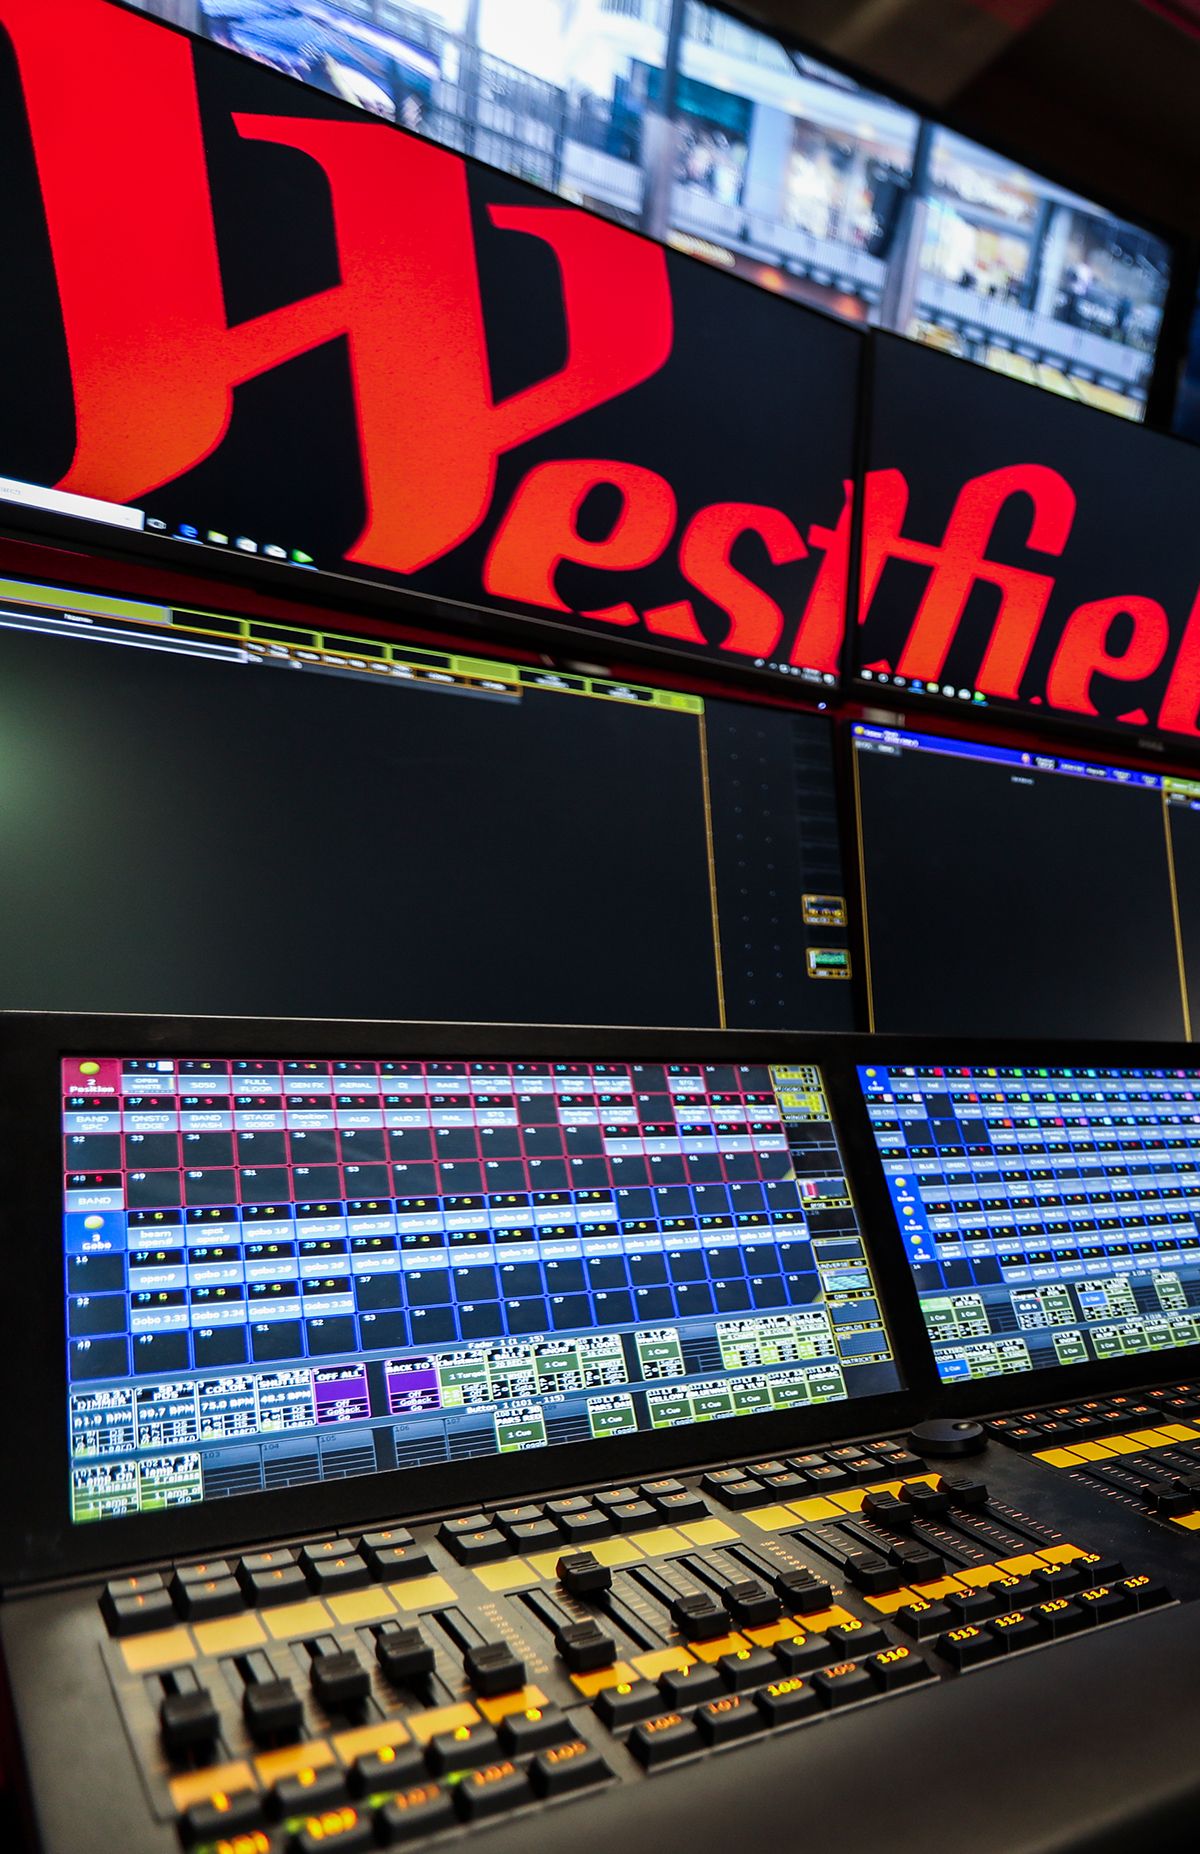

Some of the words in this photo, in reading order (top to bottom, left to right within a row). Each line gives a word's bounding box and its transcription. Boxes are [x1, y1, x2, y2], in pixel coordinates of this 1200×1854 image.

[69, 1085, 114, 1093] Position
[78, 1197, 112, 1206] BAND
[82, 1241, 112, 1251] Gobo
[834, 1448, 850, 1456] 14
[852, 1459, 869, 1467] 14
[652, 1479, 669, 1488] 10
[772, 1474, 789, 1482] 12
[669, 1492, 686, 1501] 10
[474, 1532, 485, 1541] 6
[1082, 1553, 1101, 1564] 15
[1042, 1564, 1061, 1575] 14
[1000, 1576, 1020, 1588] 13
[1123, 1575, 1151, 1589] 115
[956, 1589, 976, 1599] 12
[1082, 1586, 1110, 1601] 114
[909, 1600, 931, 1613] 11
[1039, 1599, 1070, 1614] 113
[994, 1612, 1025, 1628] 112
[839, 1619, 864, 1633] 10
[948, 1625, 980, 1642] 111
[876, 1646, 910, 1665] 110
[767, 1677, 804, 1697] 108
[707, 1696, 741, 1714] 107
